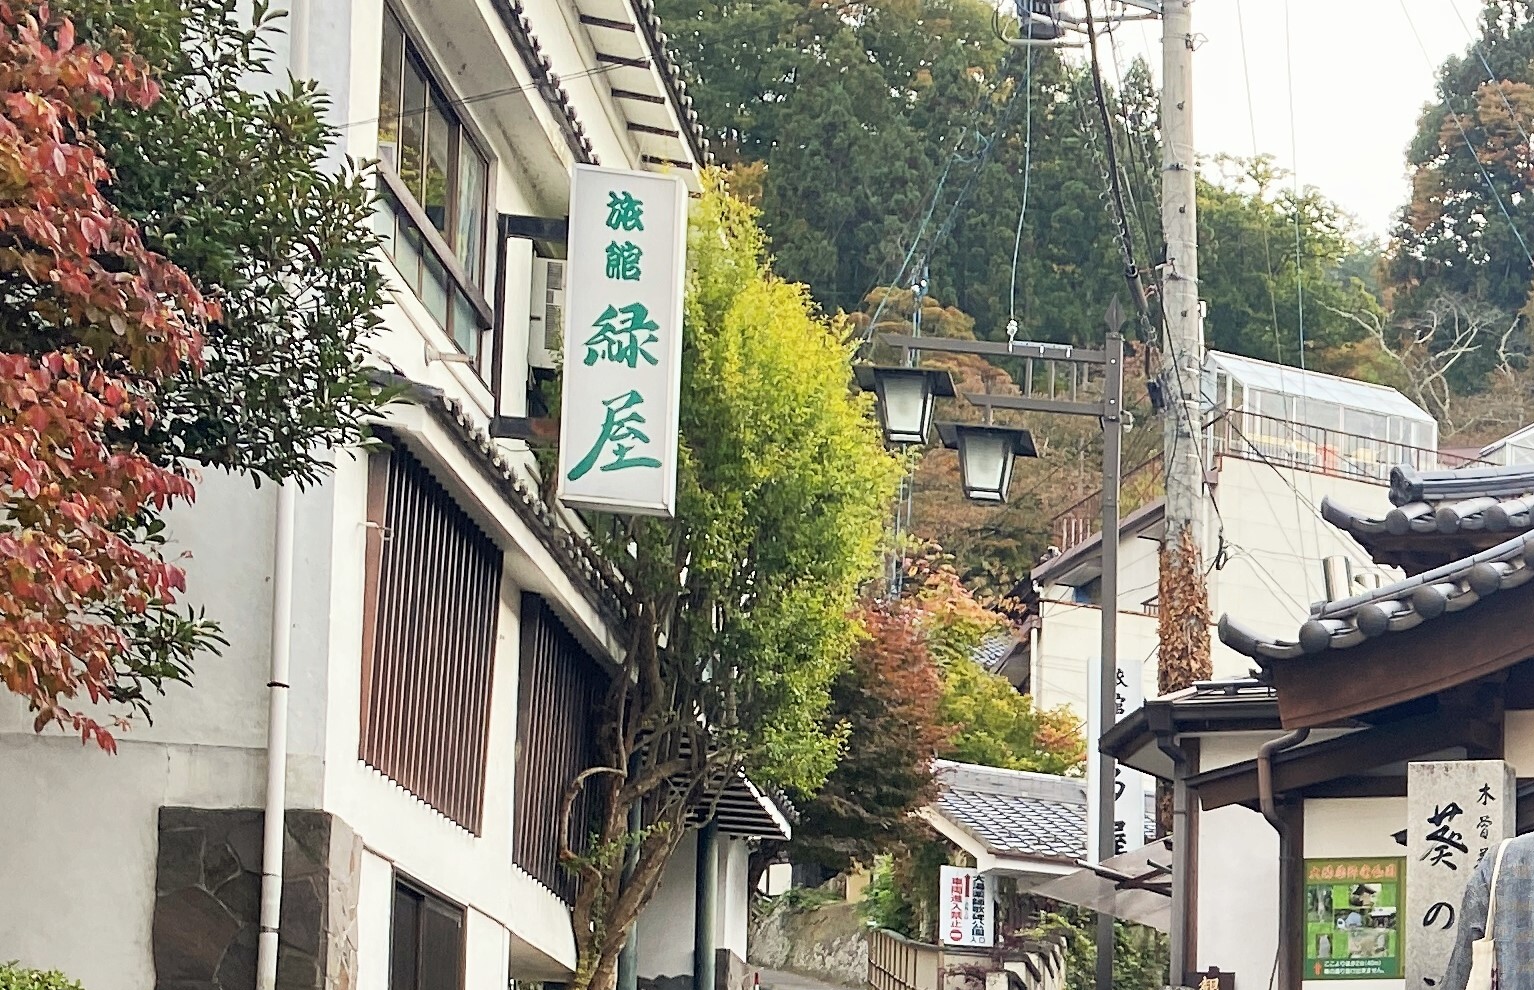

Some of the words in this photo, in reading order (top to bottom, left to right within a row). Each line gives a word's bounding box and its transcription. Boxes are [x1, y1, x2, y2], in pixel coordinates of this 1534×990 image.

[950, 876, 963, 928] 車両進入禁止
